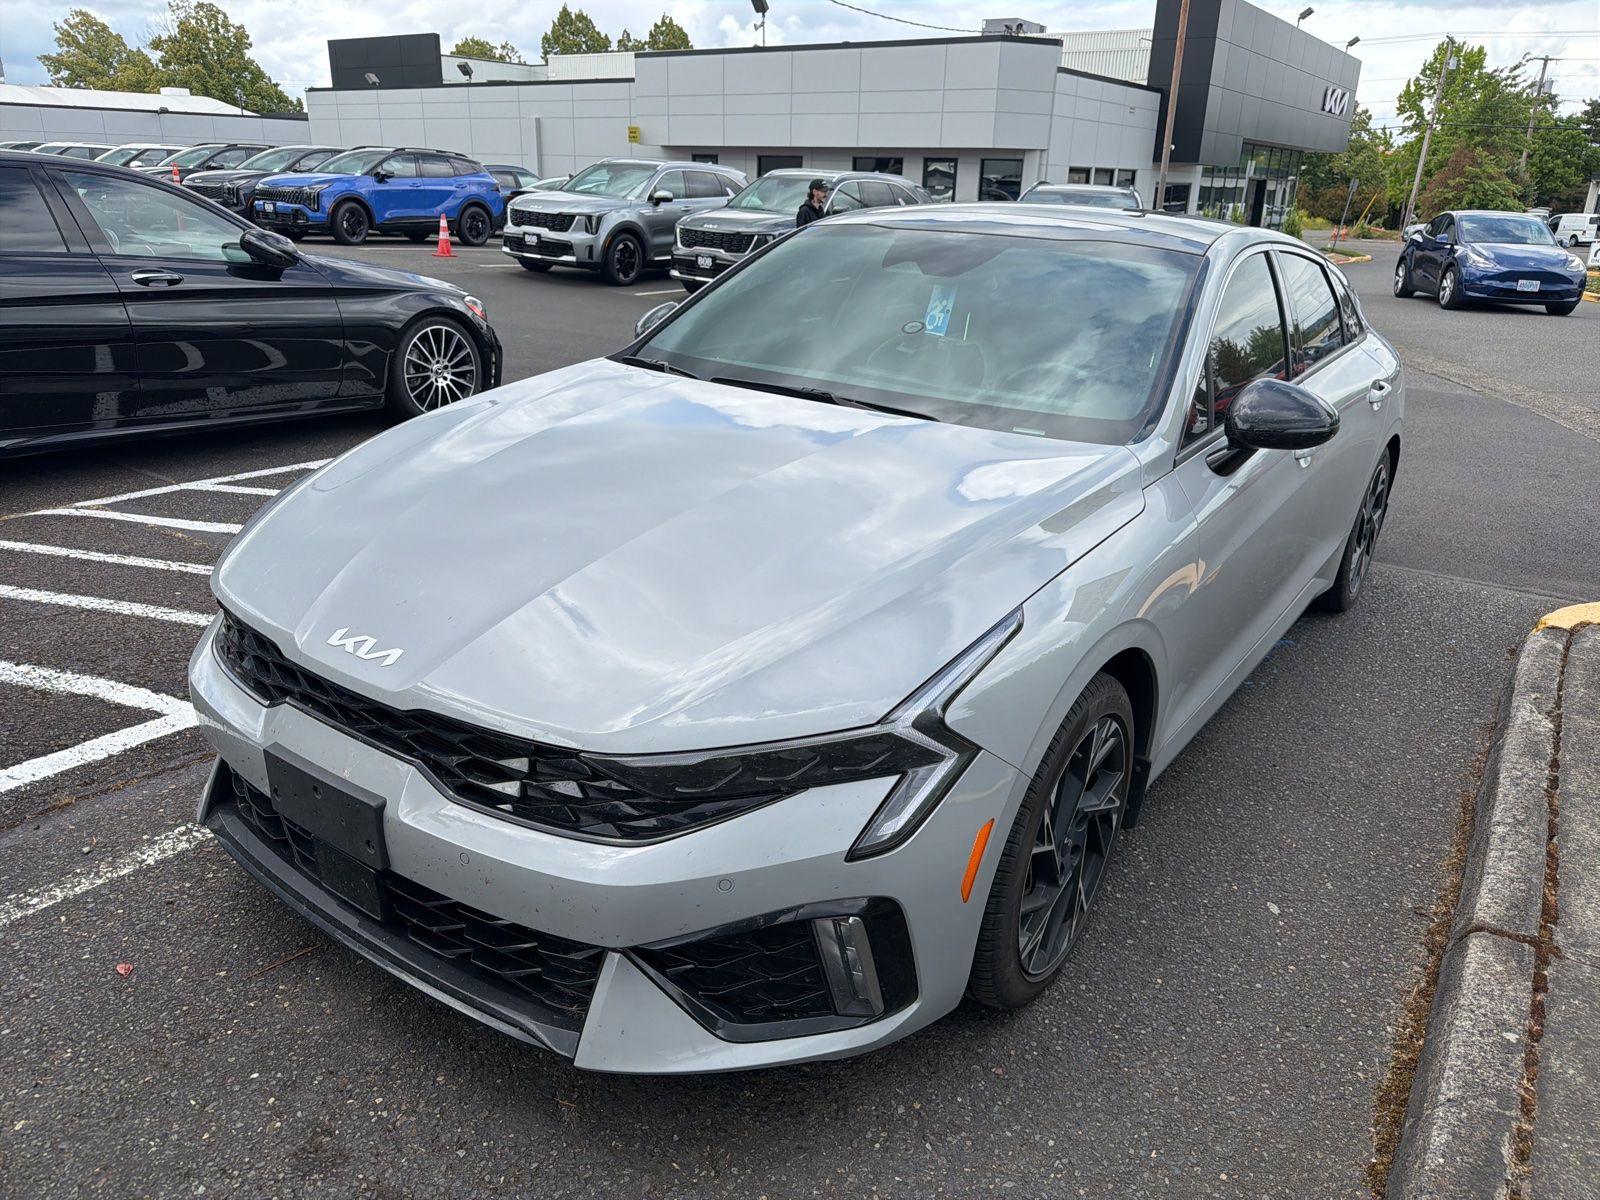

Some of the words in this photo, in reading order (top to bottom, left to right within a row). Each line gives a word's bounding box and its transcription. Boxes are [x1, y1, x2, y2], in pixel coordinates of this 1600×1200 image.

[1323, 86, 1350, 117] KIA
[697, 256, 712, 267] BOB
[327, 627, 403, 667] KIA
